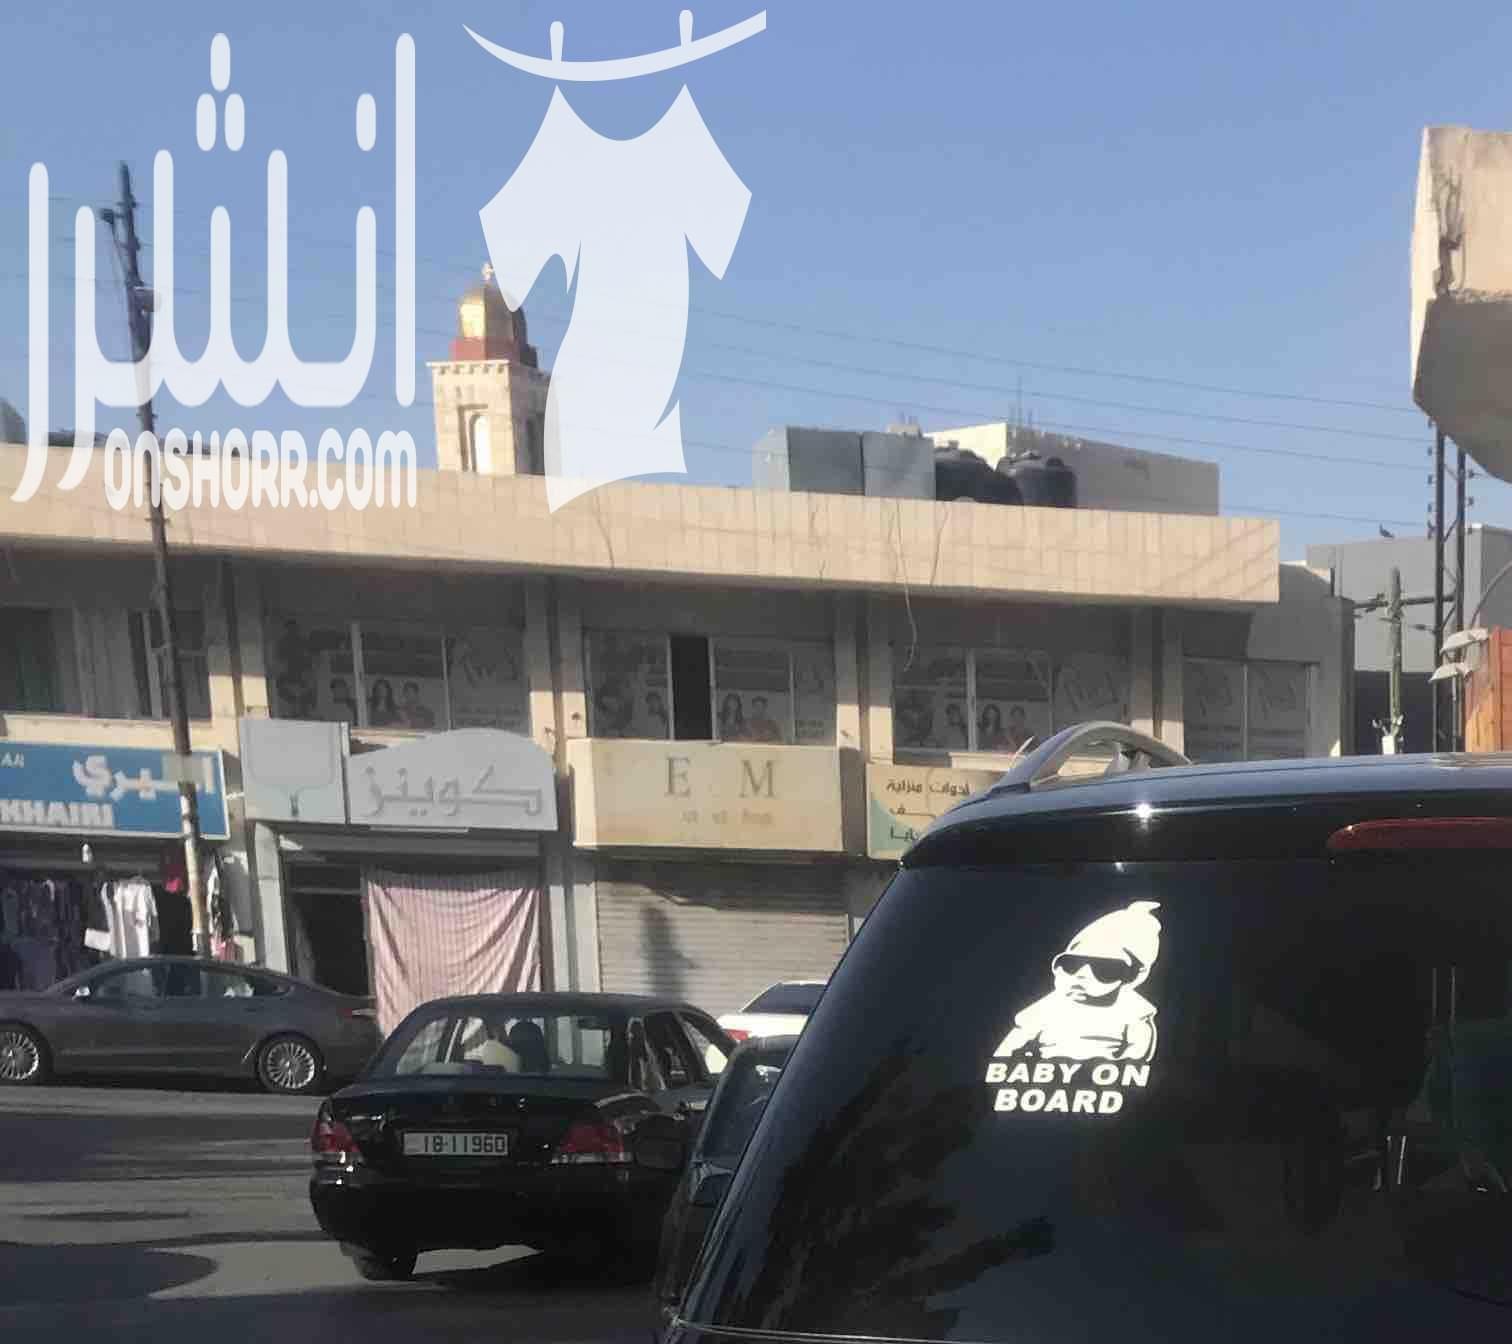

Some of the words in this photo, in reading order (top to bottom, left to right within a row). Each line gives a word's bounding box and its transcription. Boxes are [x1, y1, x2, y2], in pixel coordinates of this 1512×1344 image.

[361, 764, 542, 816] كوينز
[984, 1063, 1082, 1083] BABY
[1091, 1064, 1150, 1086] ON
[994, 1089, 1123, 1113] BOARD
